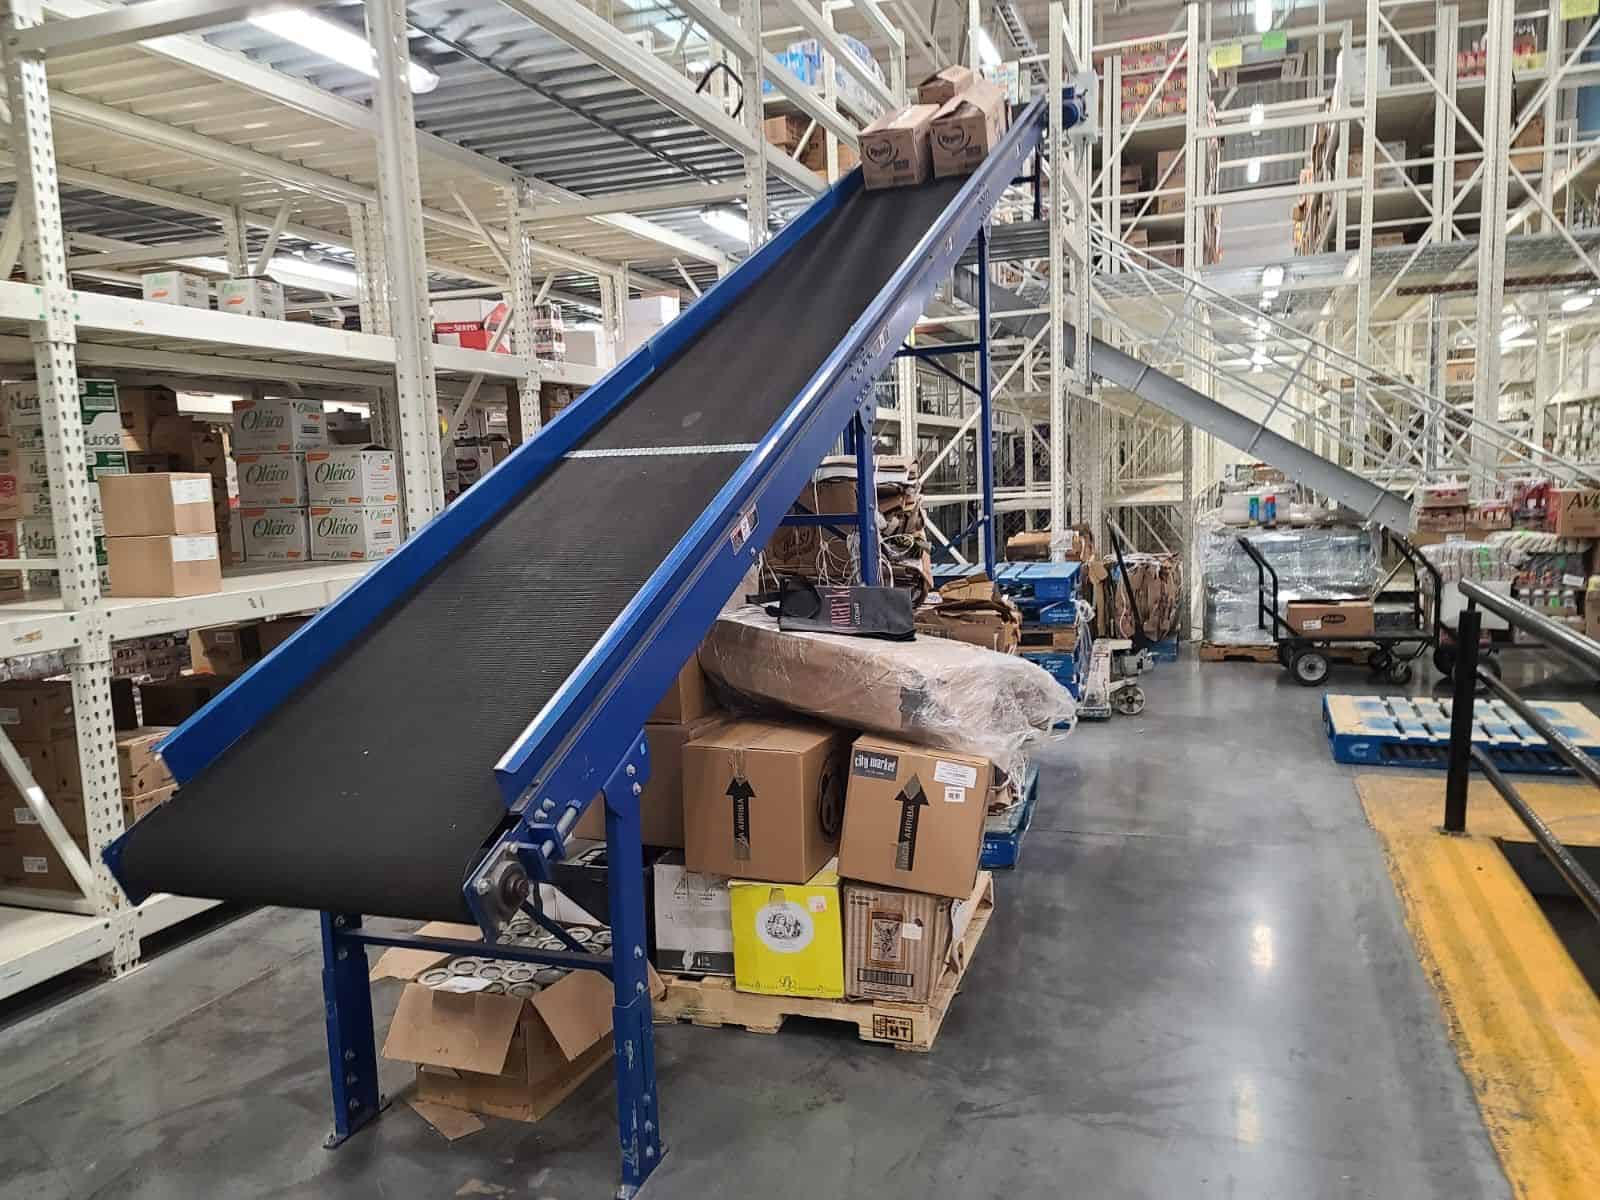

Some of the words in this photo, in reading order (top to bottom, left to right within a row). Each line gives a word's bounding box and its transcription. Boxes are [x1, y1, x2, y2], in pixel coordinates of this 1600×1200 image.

[870, 757, 897, 772] market
[904, 806, 914, 840] ARRIBA
[889, 1025, 910, 1038] HT
